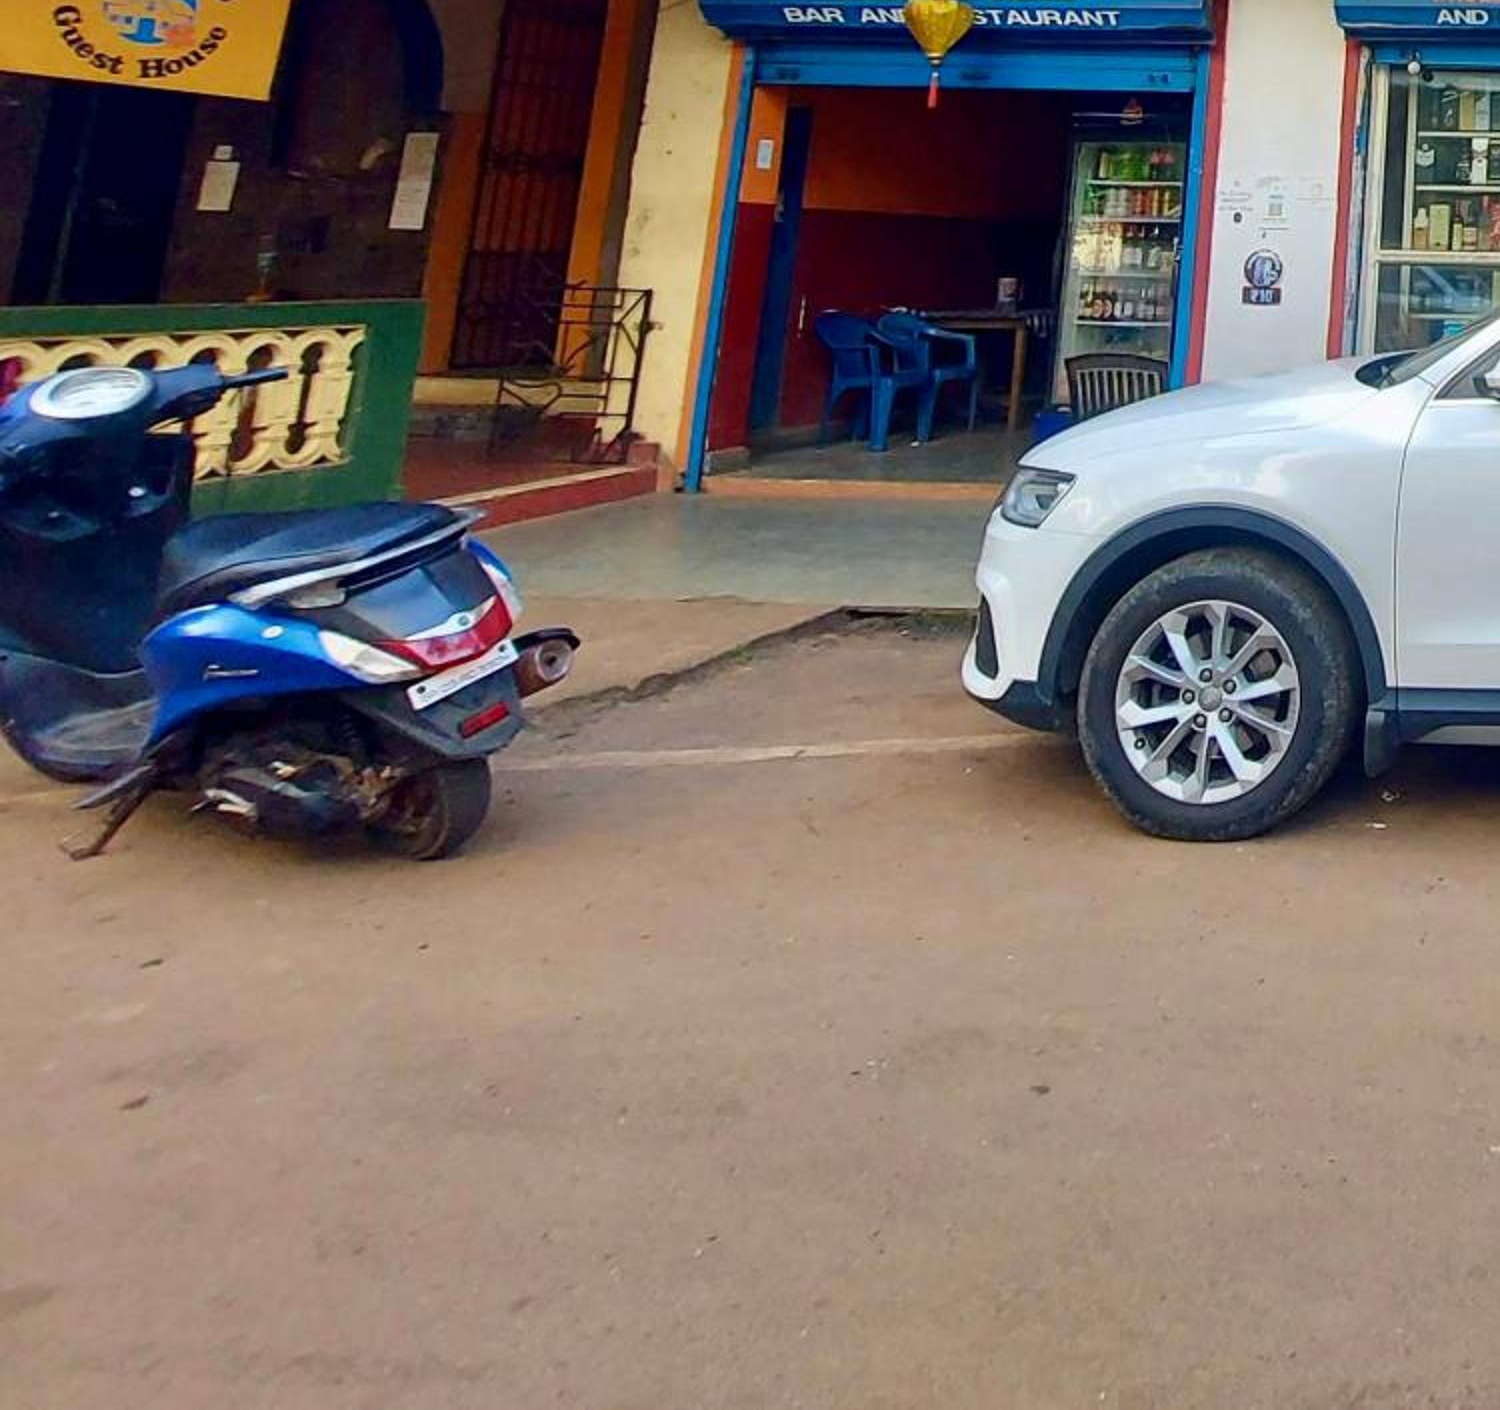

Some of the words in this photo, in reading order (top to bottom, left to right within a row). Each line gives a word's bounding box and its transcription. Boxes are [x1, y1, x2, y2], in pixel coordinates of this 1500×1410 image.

[783, 6, 845, 23] BAR
[1437, 9, 1488, 24] AND
[53, 4, 125, 75] Guest
[138, 25, 228, 79] House
